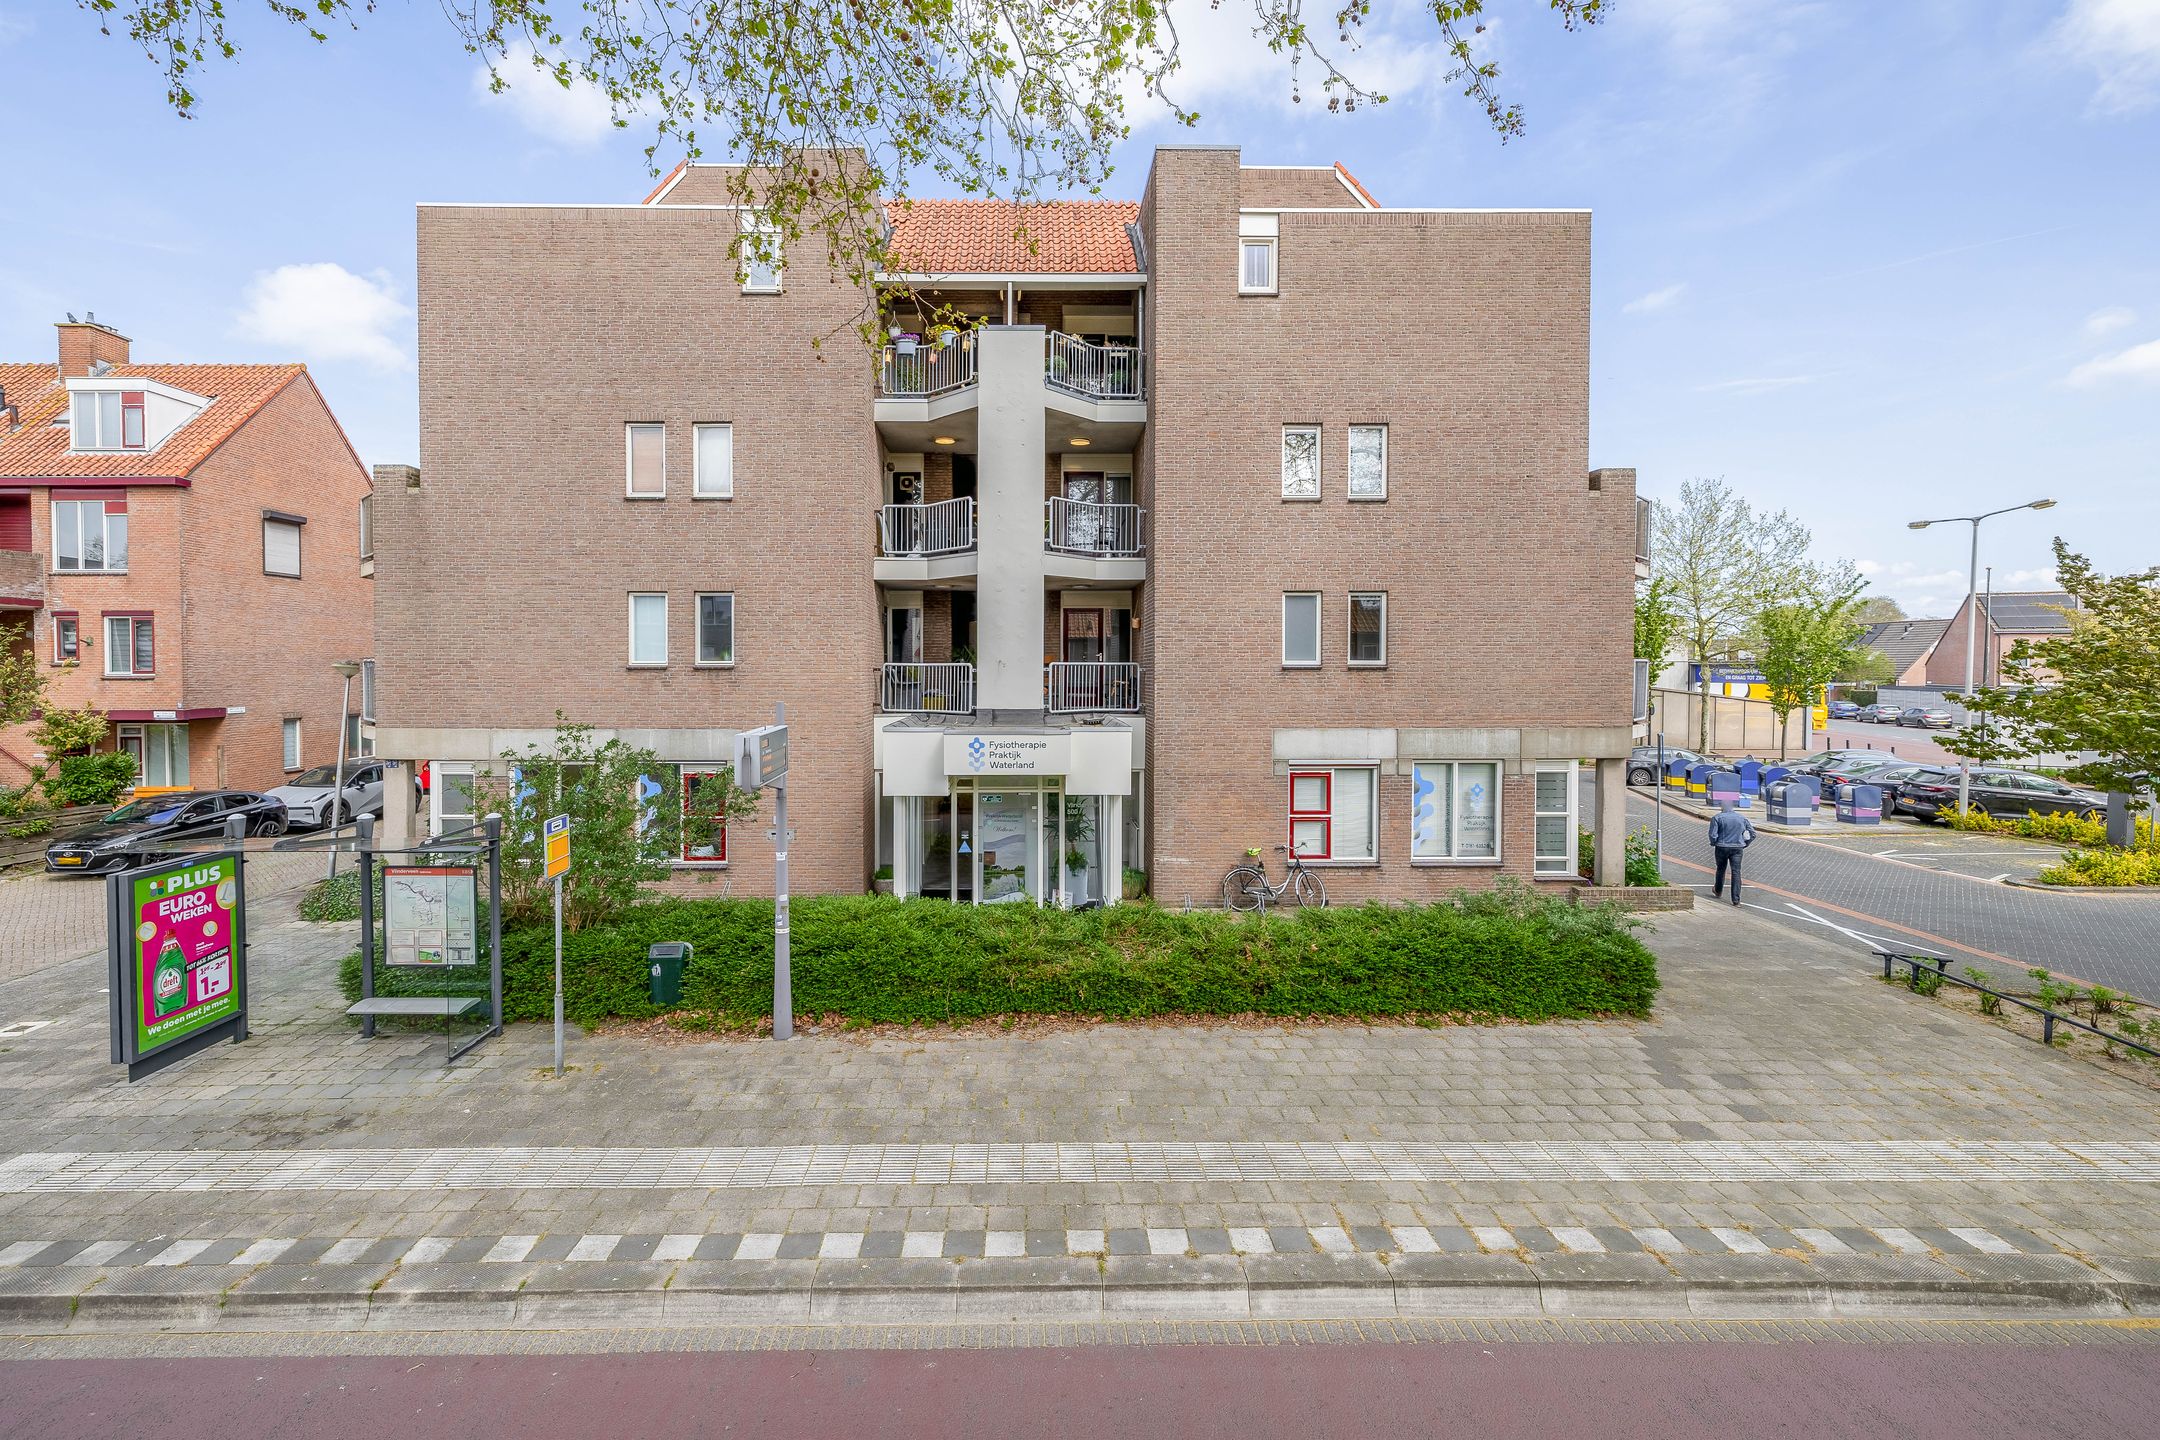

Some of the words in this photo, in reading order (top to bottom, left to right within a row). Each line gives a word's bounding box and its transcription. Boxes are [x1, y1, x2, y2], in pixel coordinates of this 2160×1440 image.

[989, 740, 1047, 751] Fysiotherapie
[989, 751, 1022, 760] Praktijk
[989, 761, 1035, 769] Waterland
[167, 865, 221, 893] PLUS
[159, 891, 206, 917] EURO
[170, 903, 212, 924] WEKEN
[163, 975, 178, 988] dreft
[147, 1025, 162, 1036] We
[162, 1015, 185, 1030] doen
[186, 1007, 203, 1020] met
[203, 1004, 211, 1014] je
[211, 997, 231, 1009] mee.
